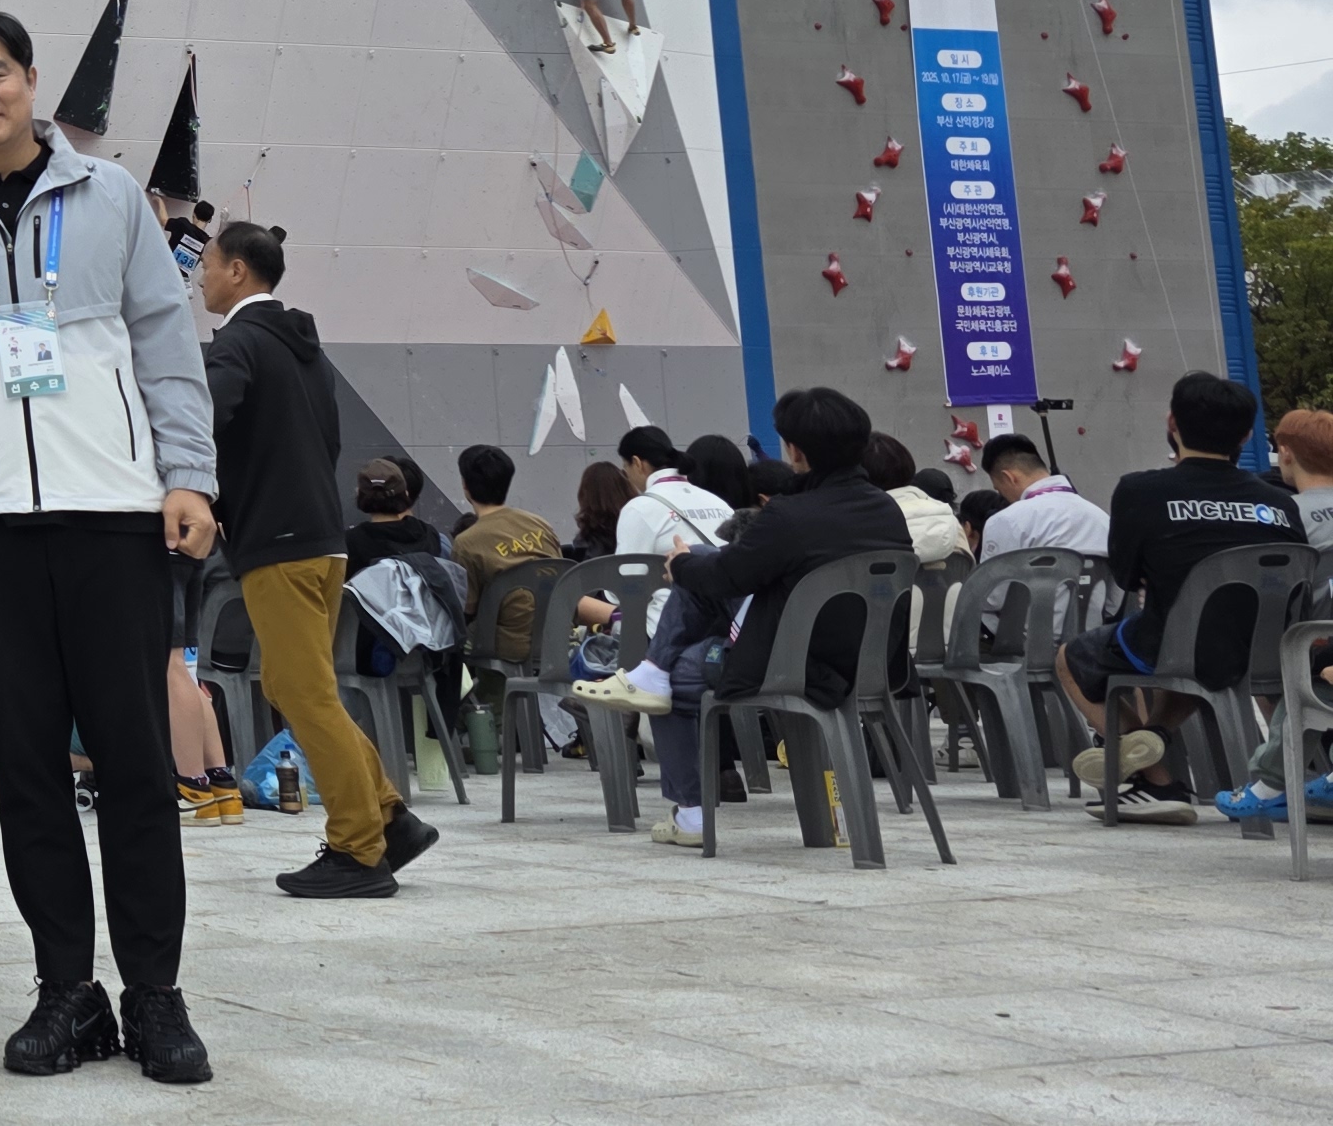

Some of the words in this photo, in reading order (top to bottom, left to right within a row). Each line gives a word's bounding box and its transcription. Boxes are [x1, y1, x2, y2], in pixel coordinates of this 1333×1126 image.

[936, 115, 953, 127] 부산
[951, 159, 990, 171] 대한체육회
[175, 252, 195, 269] 138
[971, 365, 1011, 377] 노스페이스
[1166, 500, 1290, 528] INCHEON
[495, 530, 543, 557] EASY
